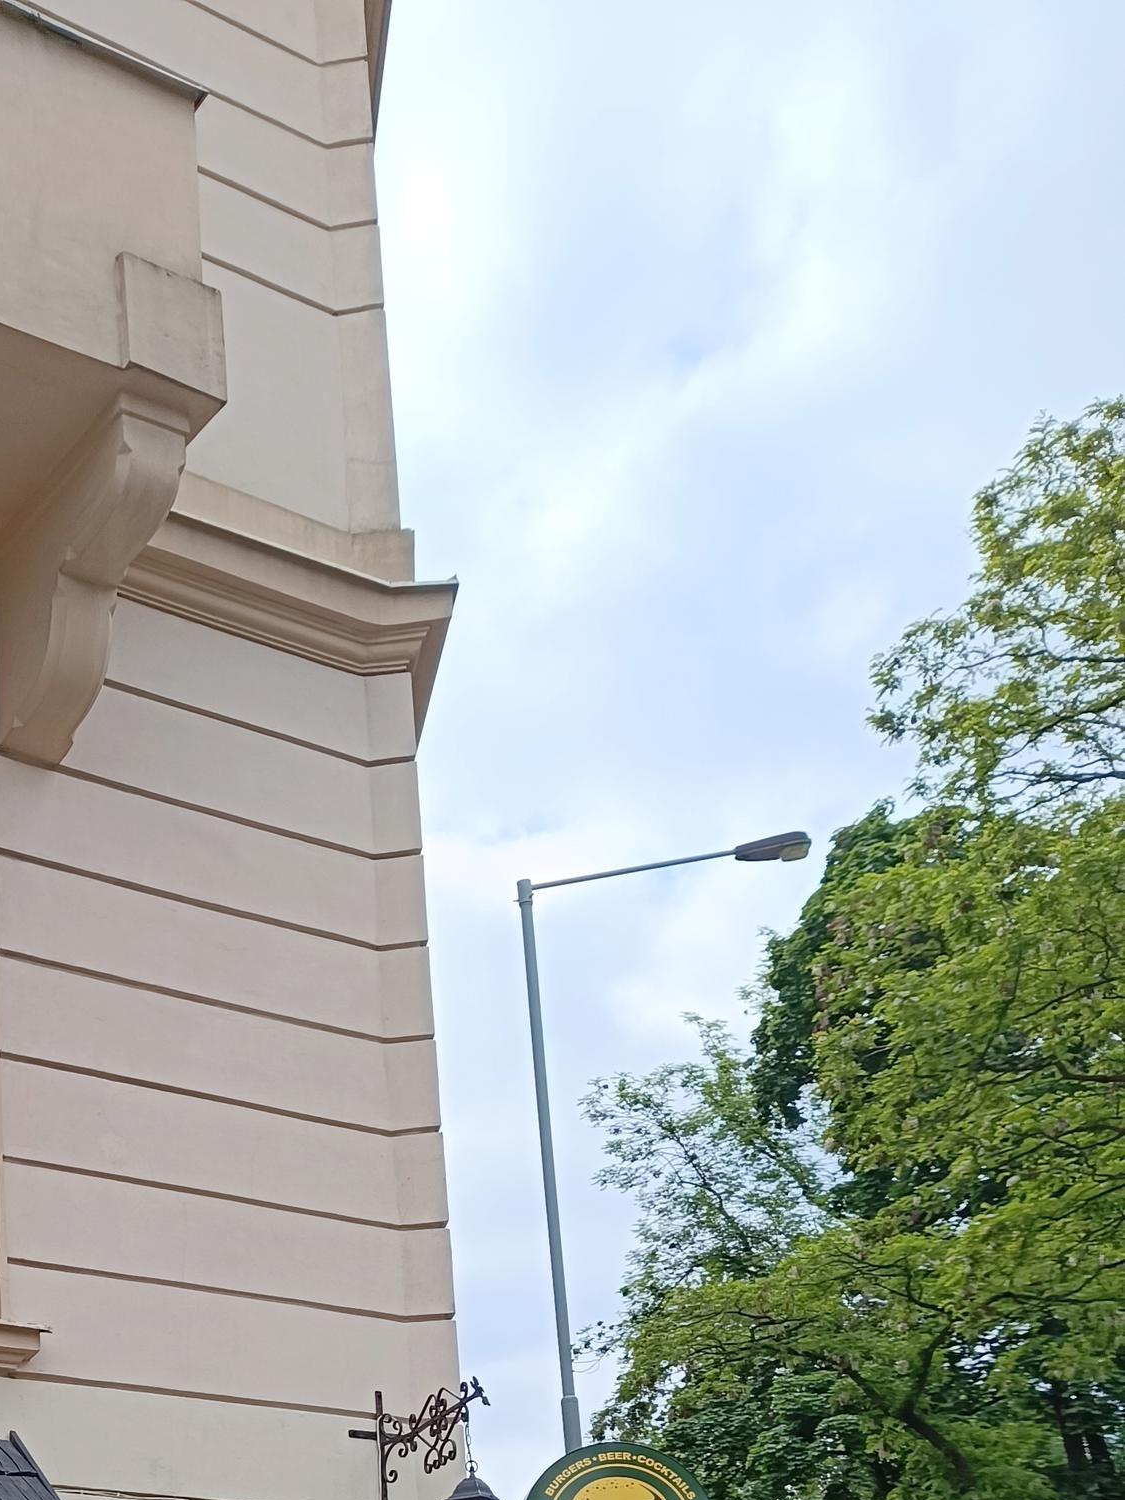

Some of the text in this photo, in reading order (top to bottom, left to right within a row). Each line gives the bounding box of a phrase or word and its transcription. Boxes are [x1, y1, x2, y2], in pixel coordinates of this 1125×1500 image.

[545, 1452, 696, 1500] BURGERS BEER COCKTAILS
